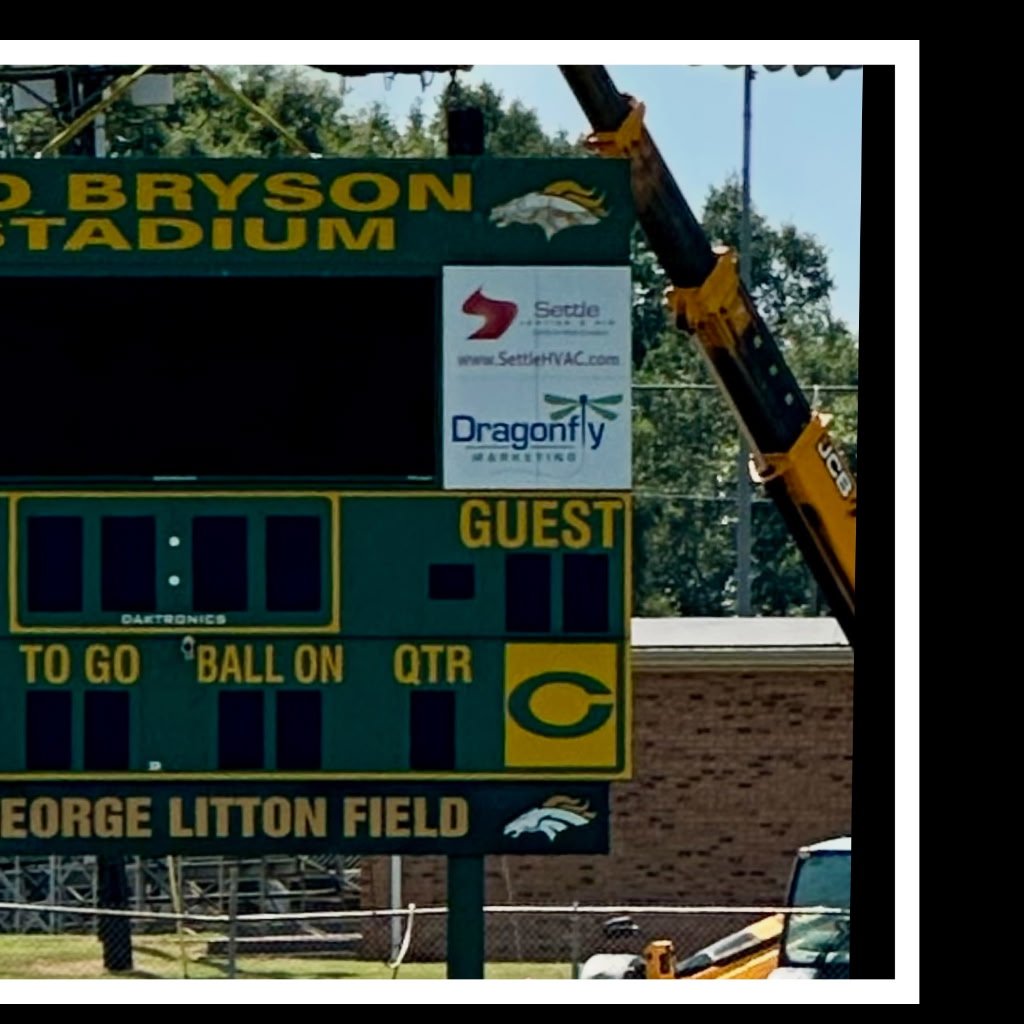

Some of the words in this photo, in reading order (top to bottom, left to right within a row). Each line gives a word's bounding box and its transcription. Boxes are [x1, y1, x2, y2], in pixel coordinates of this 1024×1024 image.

[68, 172, 473, 213] BRYSON
[533, 301, 601, 318] Settle
[457, 351, 621, 366] www.SettleHVAC.com
[451, 410, 606, 450] Dragonfly
[471, 452, 576, 462] MARKETING
[817, 442, 852, 497] JCB
[460, 500, 624, 550] GUEST
[121, 613, 227, 625] DAKTRONICS
[19, 644, 71, 685] TO
[85, 644, 141, 685] GO
[197, 644, 284, 685] BALL
[294, 644, 344, 684] ON
[394, 643, 473, 685] QTR
[508, 671, 614, 738] C
[169, 797, 327, 838] LITTON
[343, 796, 469, 838] FIELD
